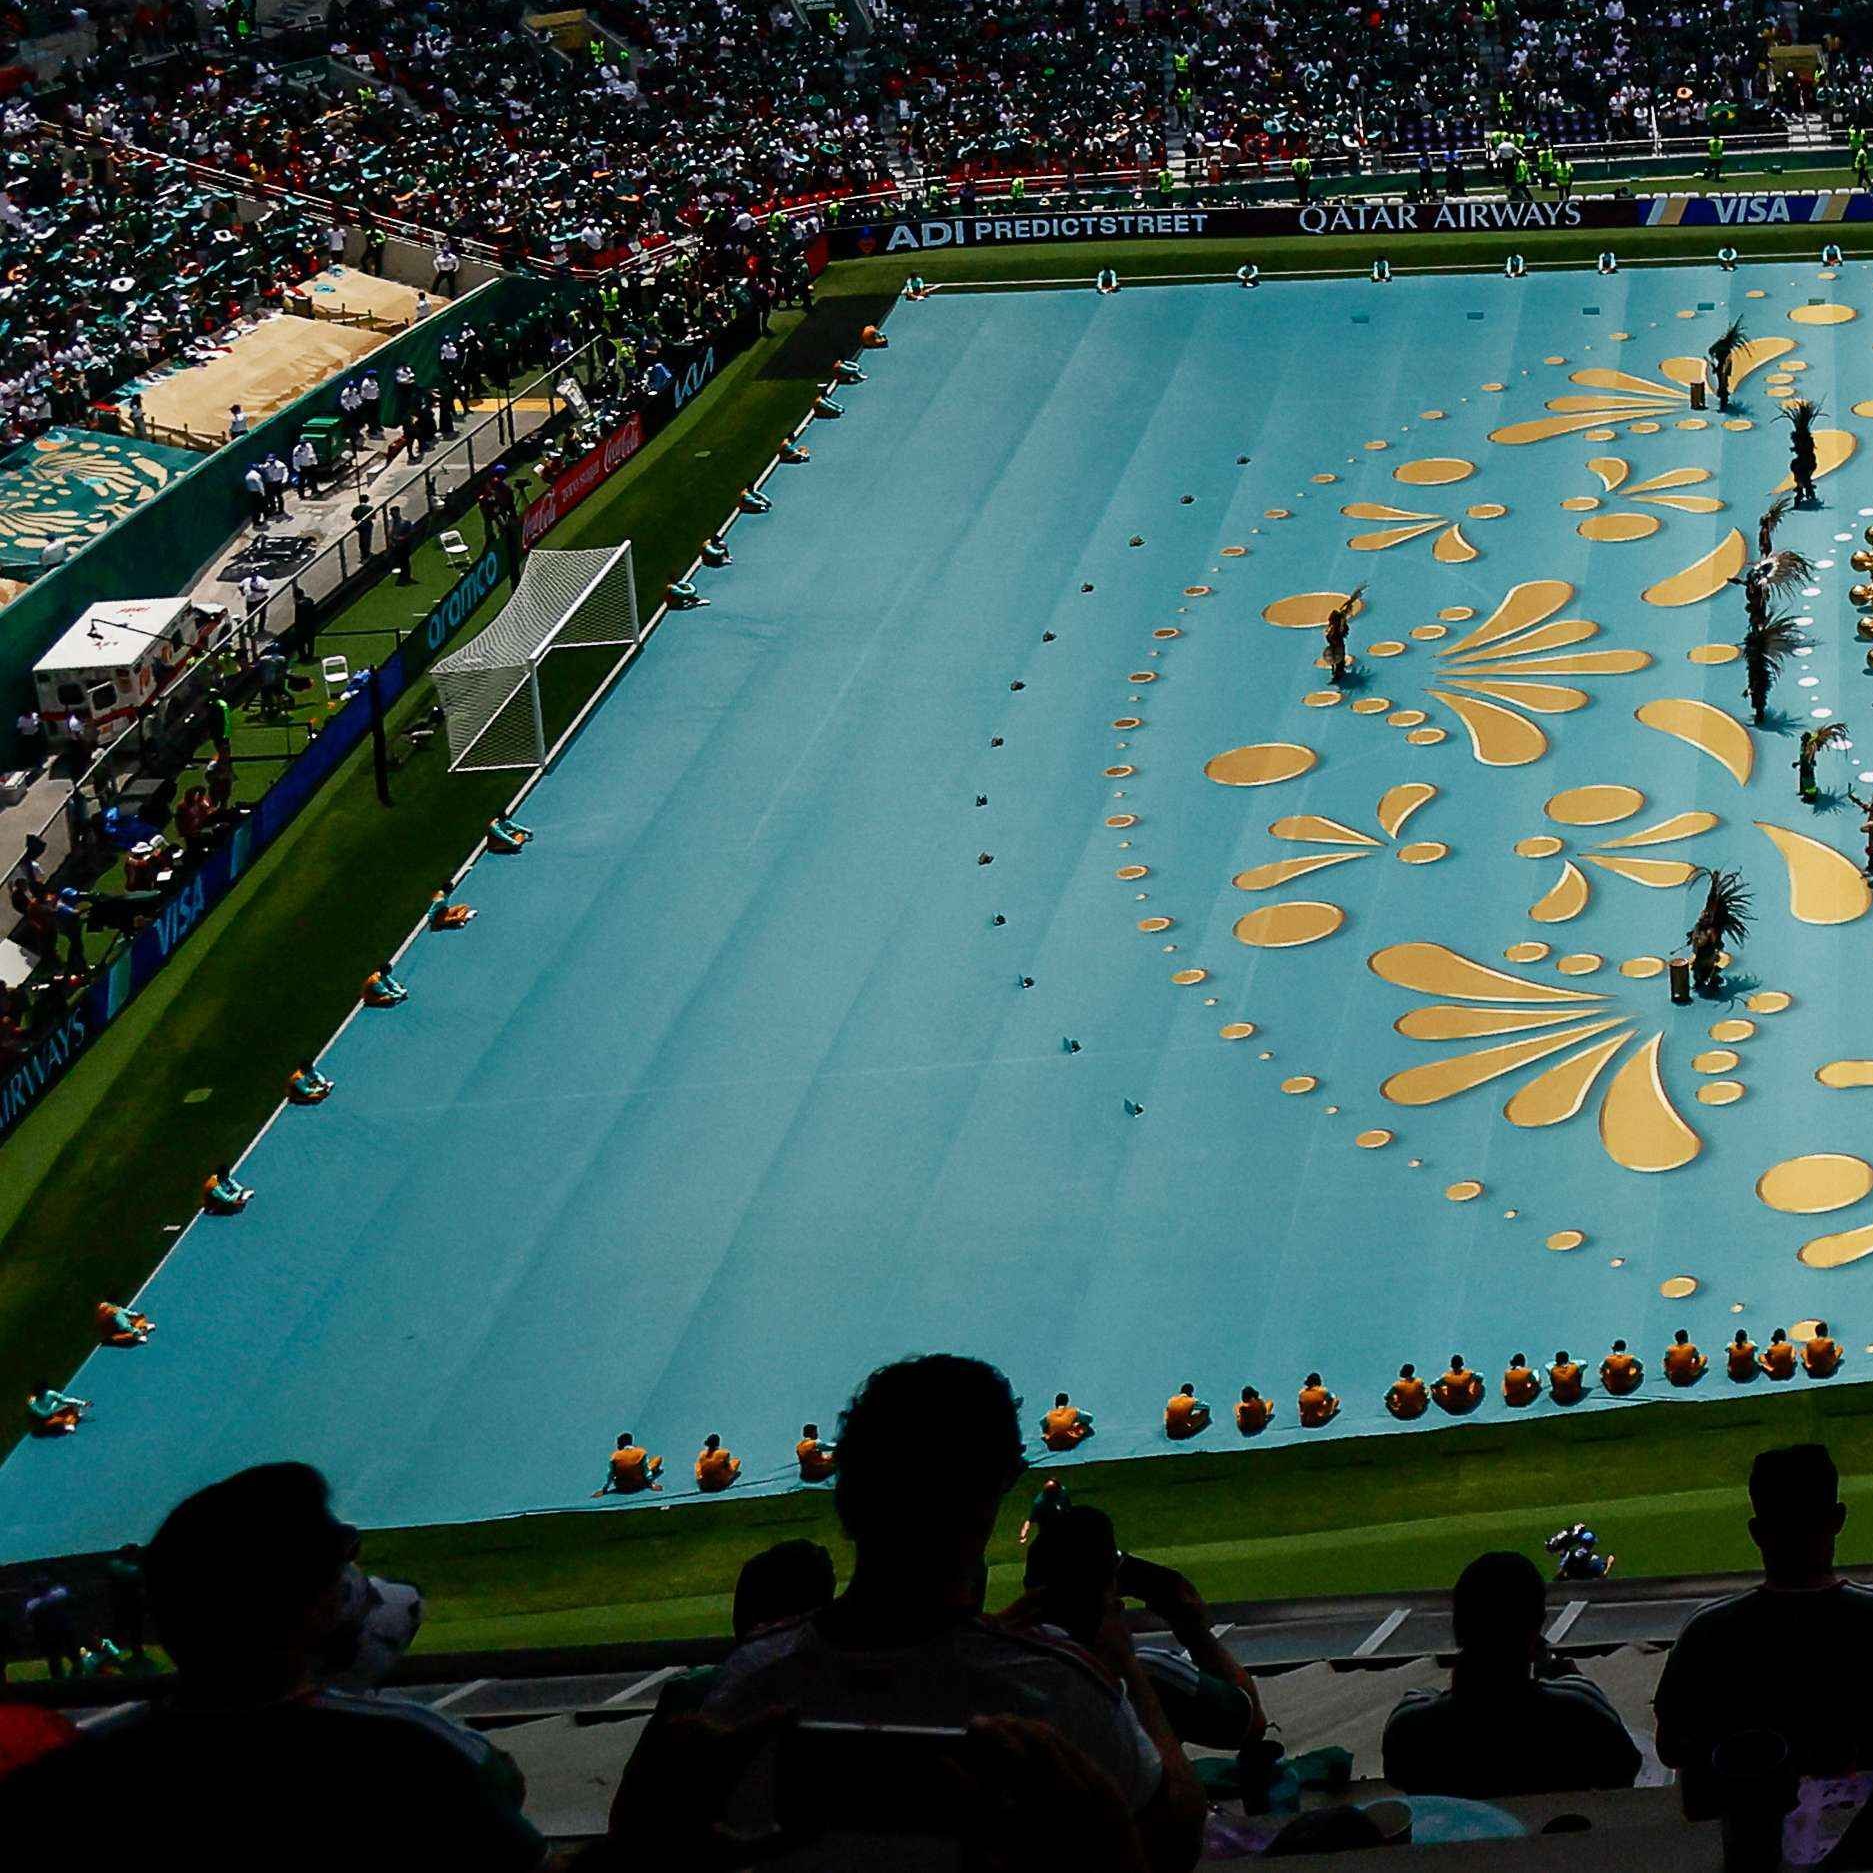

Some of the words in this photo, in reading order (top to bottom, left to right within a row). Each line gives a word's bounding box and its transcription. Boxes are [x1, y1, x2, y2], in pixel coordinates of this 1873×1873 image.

[1299, 204, 1418, 234] QATAR
[1433, 201, 1582, 229] AIRWAYS
[1711, 196, 1791, 224] VISA
[886, 221, 964, 251] ADI
[974, 214, 1208, 240] PREDICTSTREET
[427, 549, 498, 651] aramco
[153, 873, 207, 957] VISA
